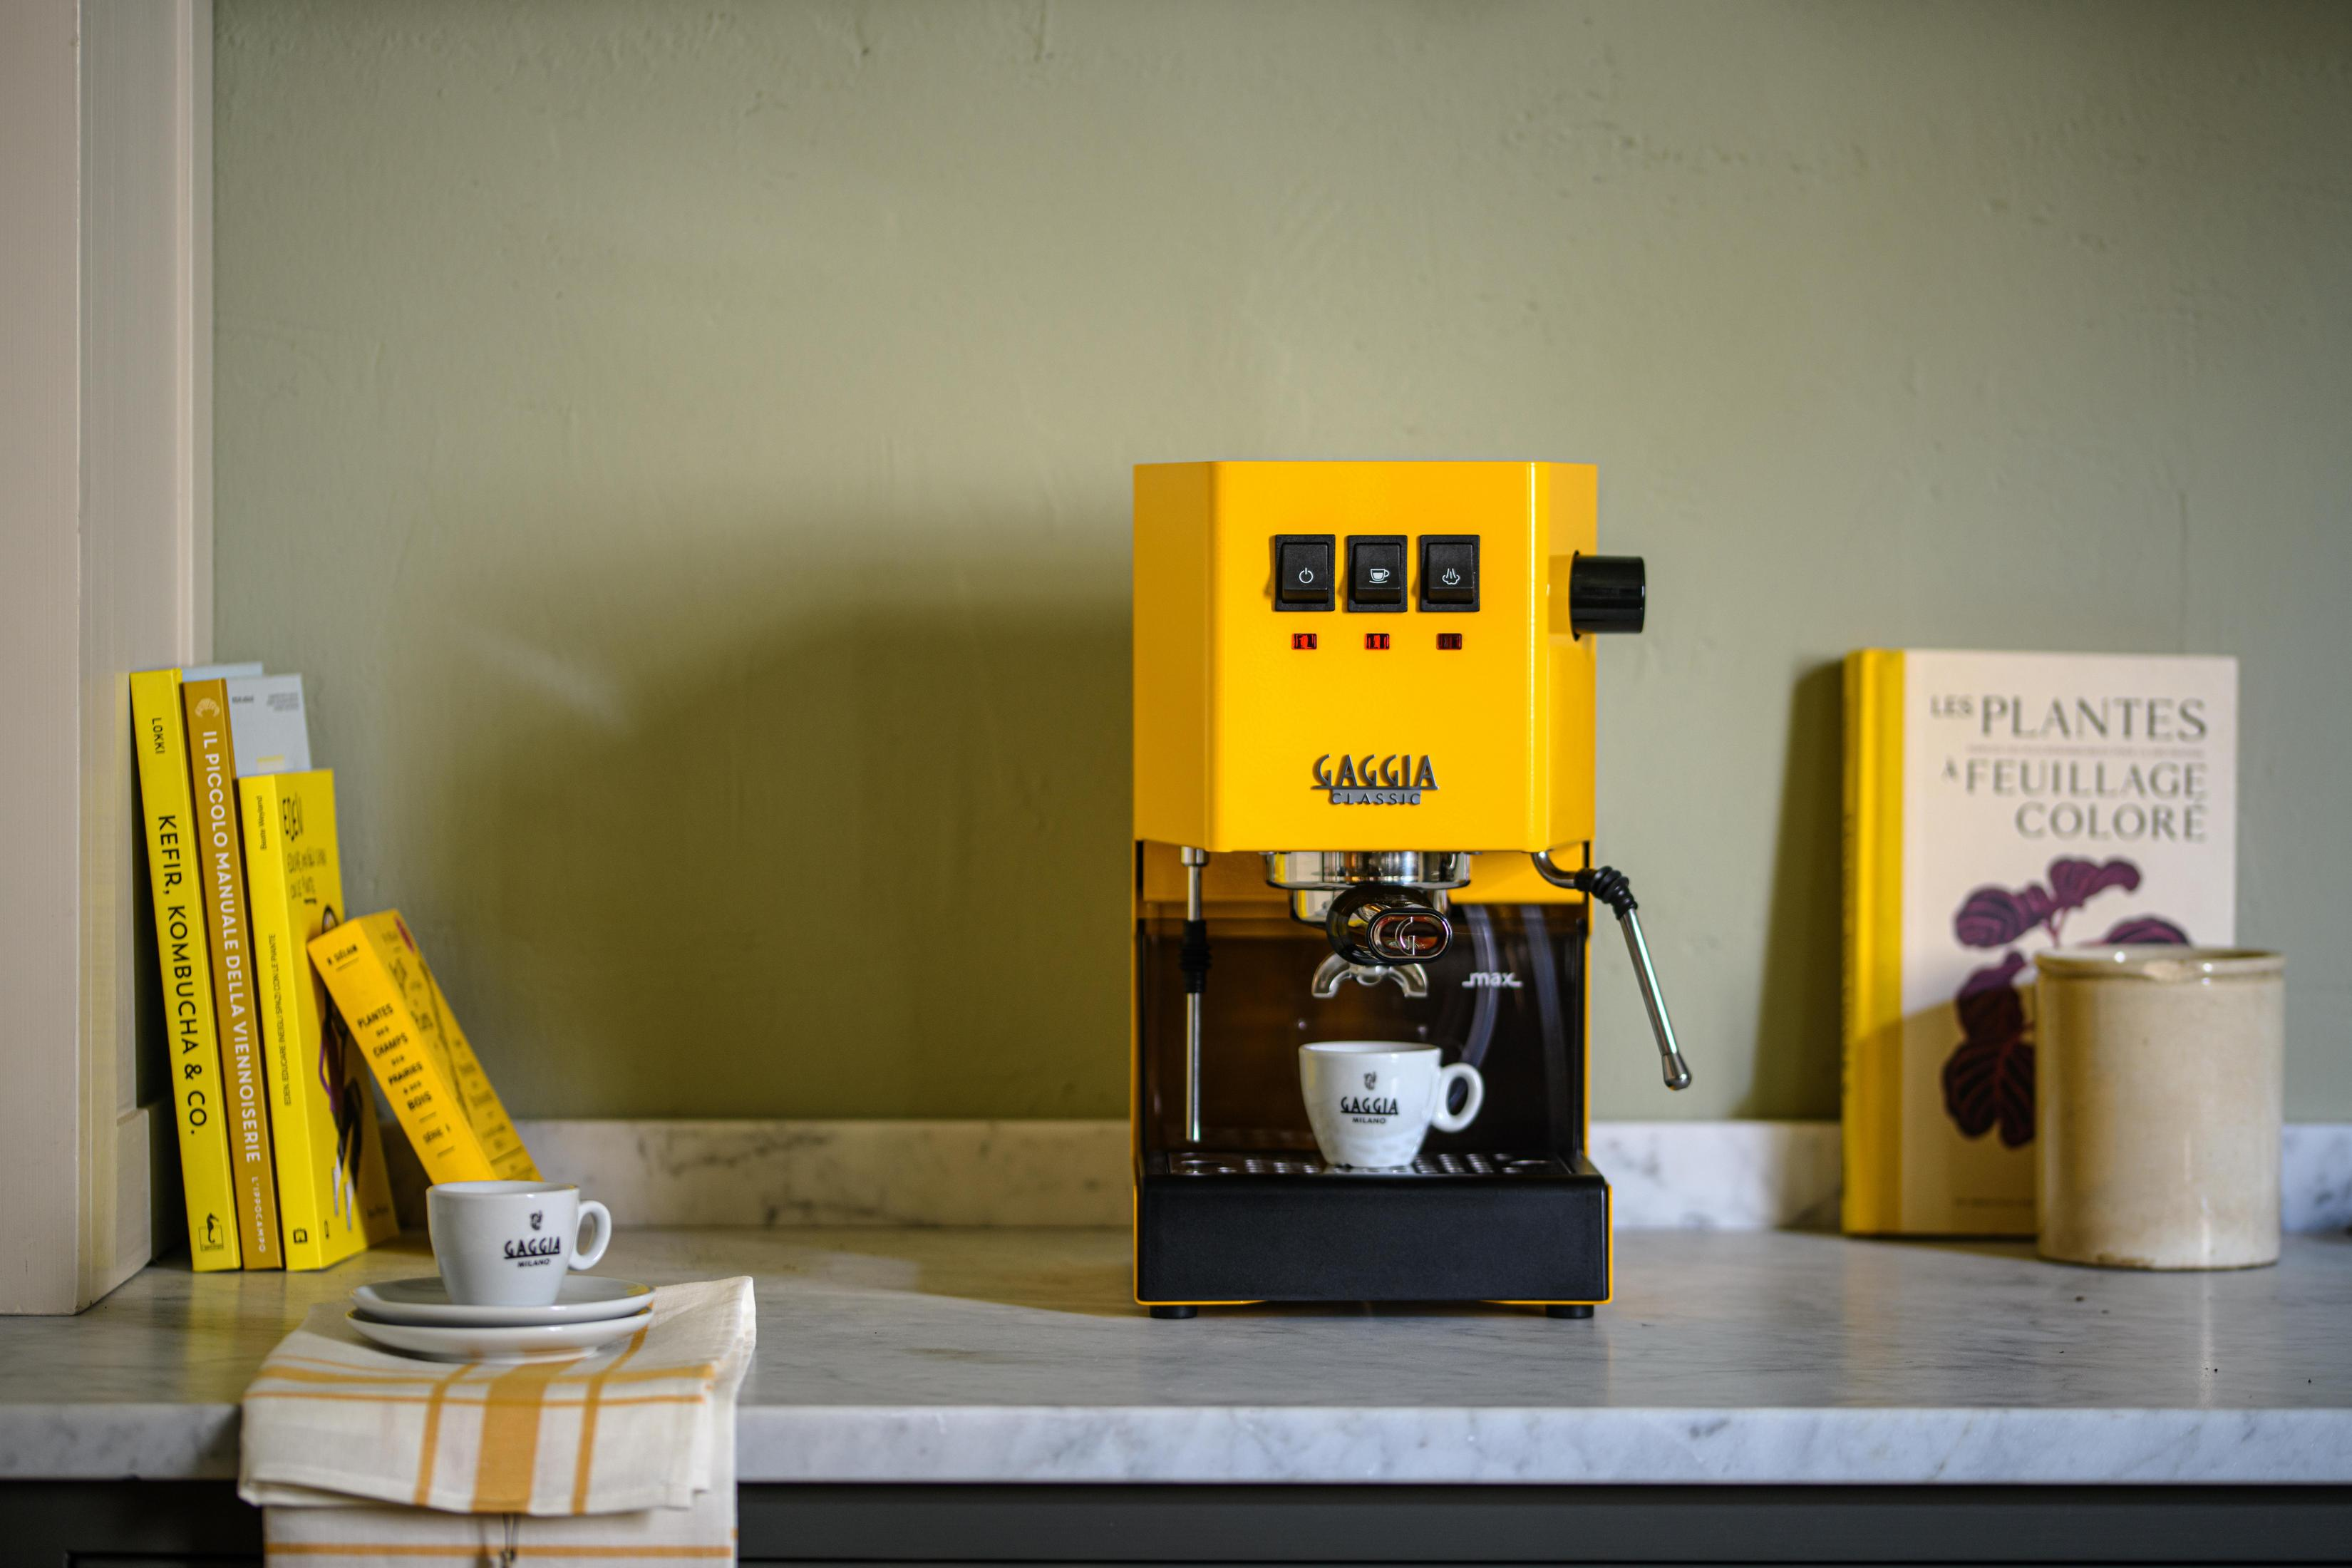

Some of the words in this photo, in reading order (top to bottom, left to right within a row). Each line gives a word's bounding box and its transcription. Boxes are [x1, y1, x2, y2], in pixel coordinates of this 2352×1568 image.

[152, 717, 165, 754] LOKKI
[1929, 694, 1973, 718] LES
[1980, 694, 2208, 742] PLANTES
[203, 731, 217, 748] IL
[1312, 753, 1438, 789] GAGGIA
[1966, 758, 2208, 801] FEUILLAGE
[205, 753, 228, 847] PICCOLO
[1331, 792, 1420, 805] CLASSIC
[158, 815, 182, 895] KEFIR,
[215, 852, 239, 951] MANUALE
[167, 905, 199, 1055] KOMBUCHA
[226, 956, 246, 1018] DELLA
[357, 1003, 393, 1029] PLANTES
[372, 1032, 409, 1058] CHAMPS
[184, 1064, 202, 1080] &
[388, 1061, 423, 1085] PRAIRIES
[233, 1021, 261, 1163] VIENNOISERIE
[406, 1090, 432, 1111] BOIS
[1341, 1096, 1398, 1115] GAGGIA
[187, 1090, 207, 1135] CO.
[503, 1236, 561, 1259] GAGGIA
[517, 1258, 551, 1268] MILANO
